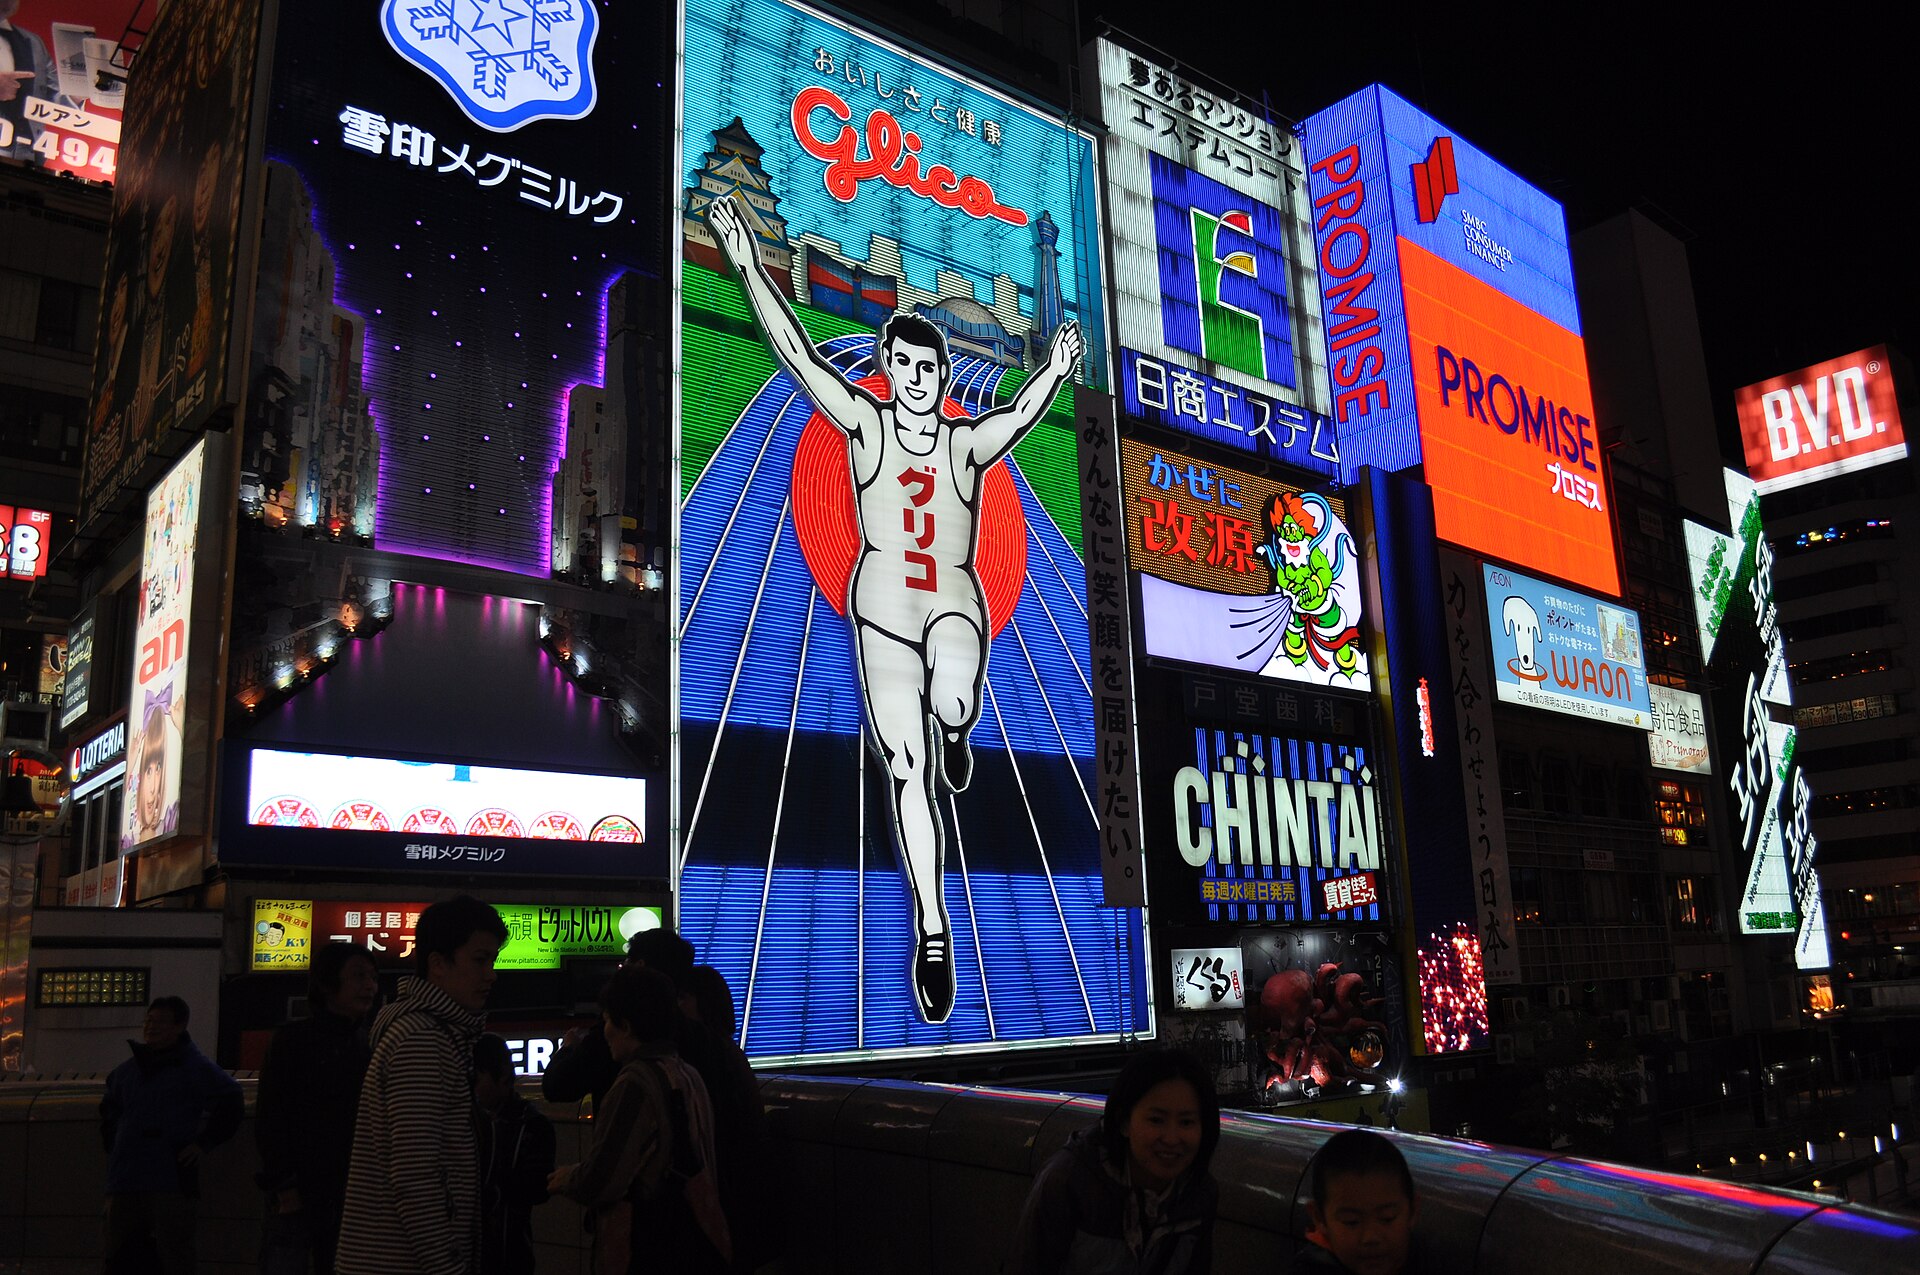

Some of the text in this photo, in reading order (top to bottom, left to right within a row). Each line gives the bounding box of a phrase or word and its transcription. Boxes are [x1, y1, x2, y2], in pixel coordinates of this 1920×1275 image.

[31, 103, 92, 128] ルアン
[814, 46, 1003, 147] おいしさと健康
[1128, 56, 1292, 157] 夢あるマンション
[339, 104, 624, 224] 雪印メグミルク
[790, 85, 1029, 225] Glico
[1130, 97, 1297, 197] エステムコート
[1461, 209, 1488, 235] SMBC
[1463, 224, 1514, 264] CONSUMER
[1465, 237, 1506, 273] FINANCE
[1311, 144, 1390, 424] PROMISE
[1135, 357, 1340, 464] 日商エステム
[1436, 345, 1597, 473] PROMISE
[1148, 453, 1243, 509] かぜに
[1546, 462, 1603, 512] プロミス
[896, 465, 938, 593] グリコ
[1139, 496, 1257, 574] 改源
[139, 618, 184, 685] an
[1084, 414, 1136, 881] みんなに笑顔を届けたい。
[1550, 649, 1632, 702] WAON
[80, 722, 126, 774] LOTTERIA
[1446, 570, 1509, 967] 力を合わせよう日本
[404, 843, 506, 862] 雪印メグミルク
[1202, 880, 1296, 902] 毎週水曜日発売
[255, 952, 309, 963] 関西インベスト
[538, 907, 614, 943] ピタットハウス
